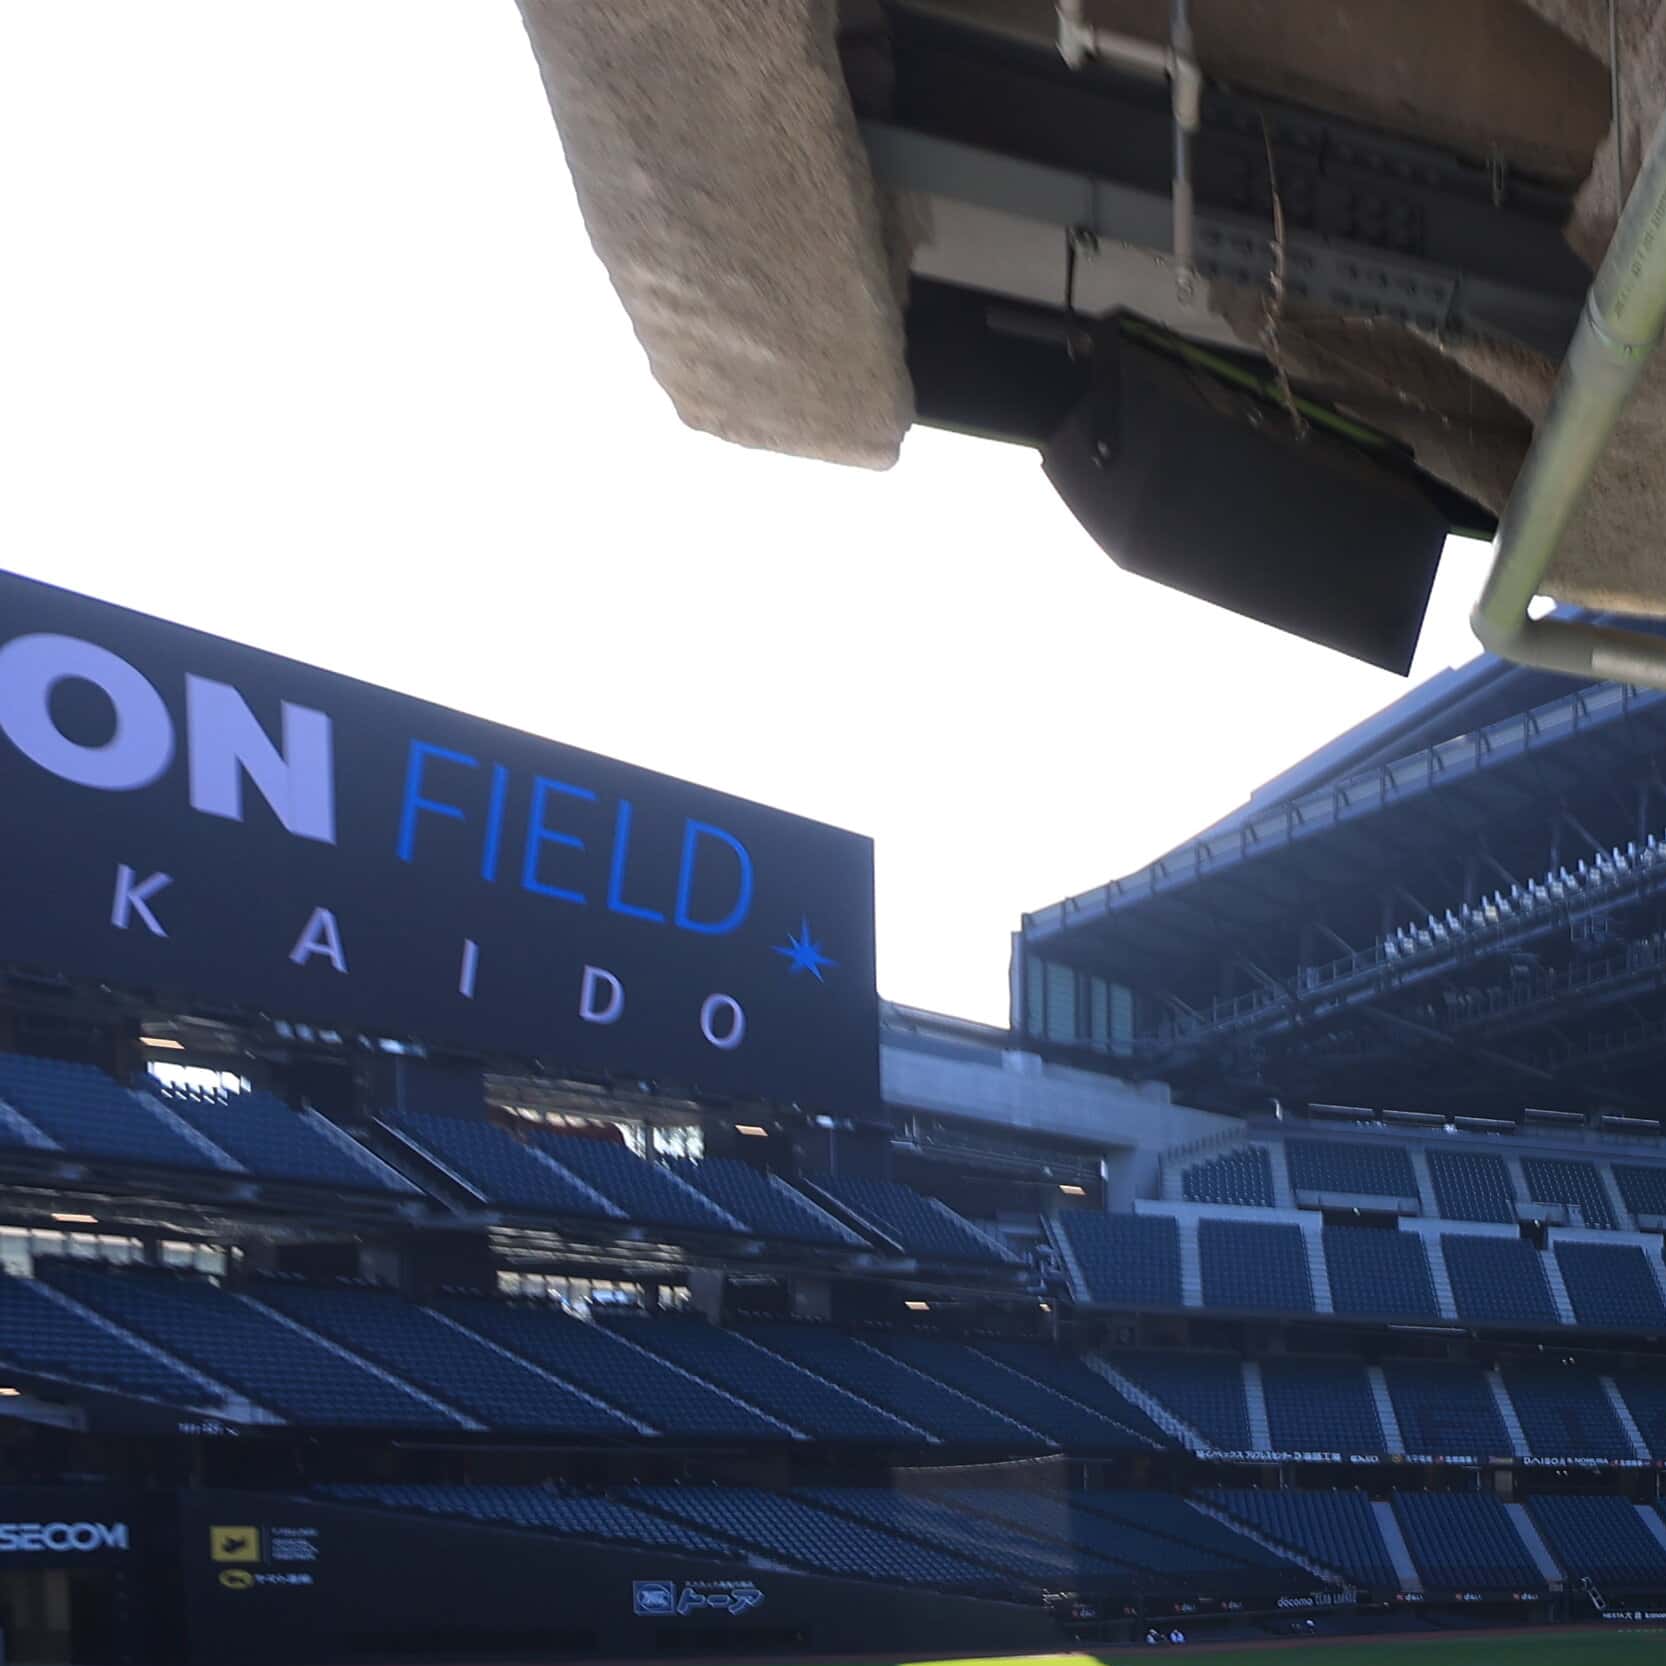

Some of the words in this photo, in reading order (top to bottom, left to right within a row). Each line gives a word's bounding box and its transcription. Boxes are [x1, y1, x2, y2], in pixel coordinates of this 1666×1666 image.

[396, 740, 755, 936] FIELD
[0, 1522, 130, 1552] SECOM
[677, 1586, 766, 1616] トーア
